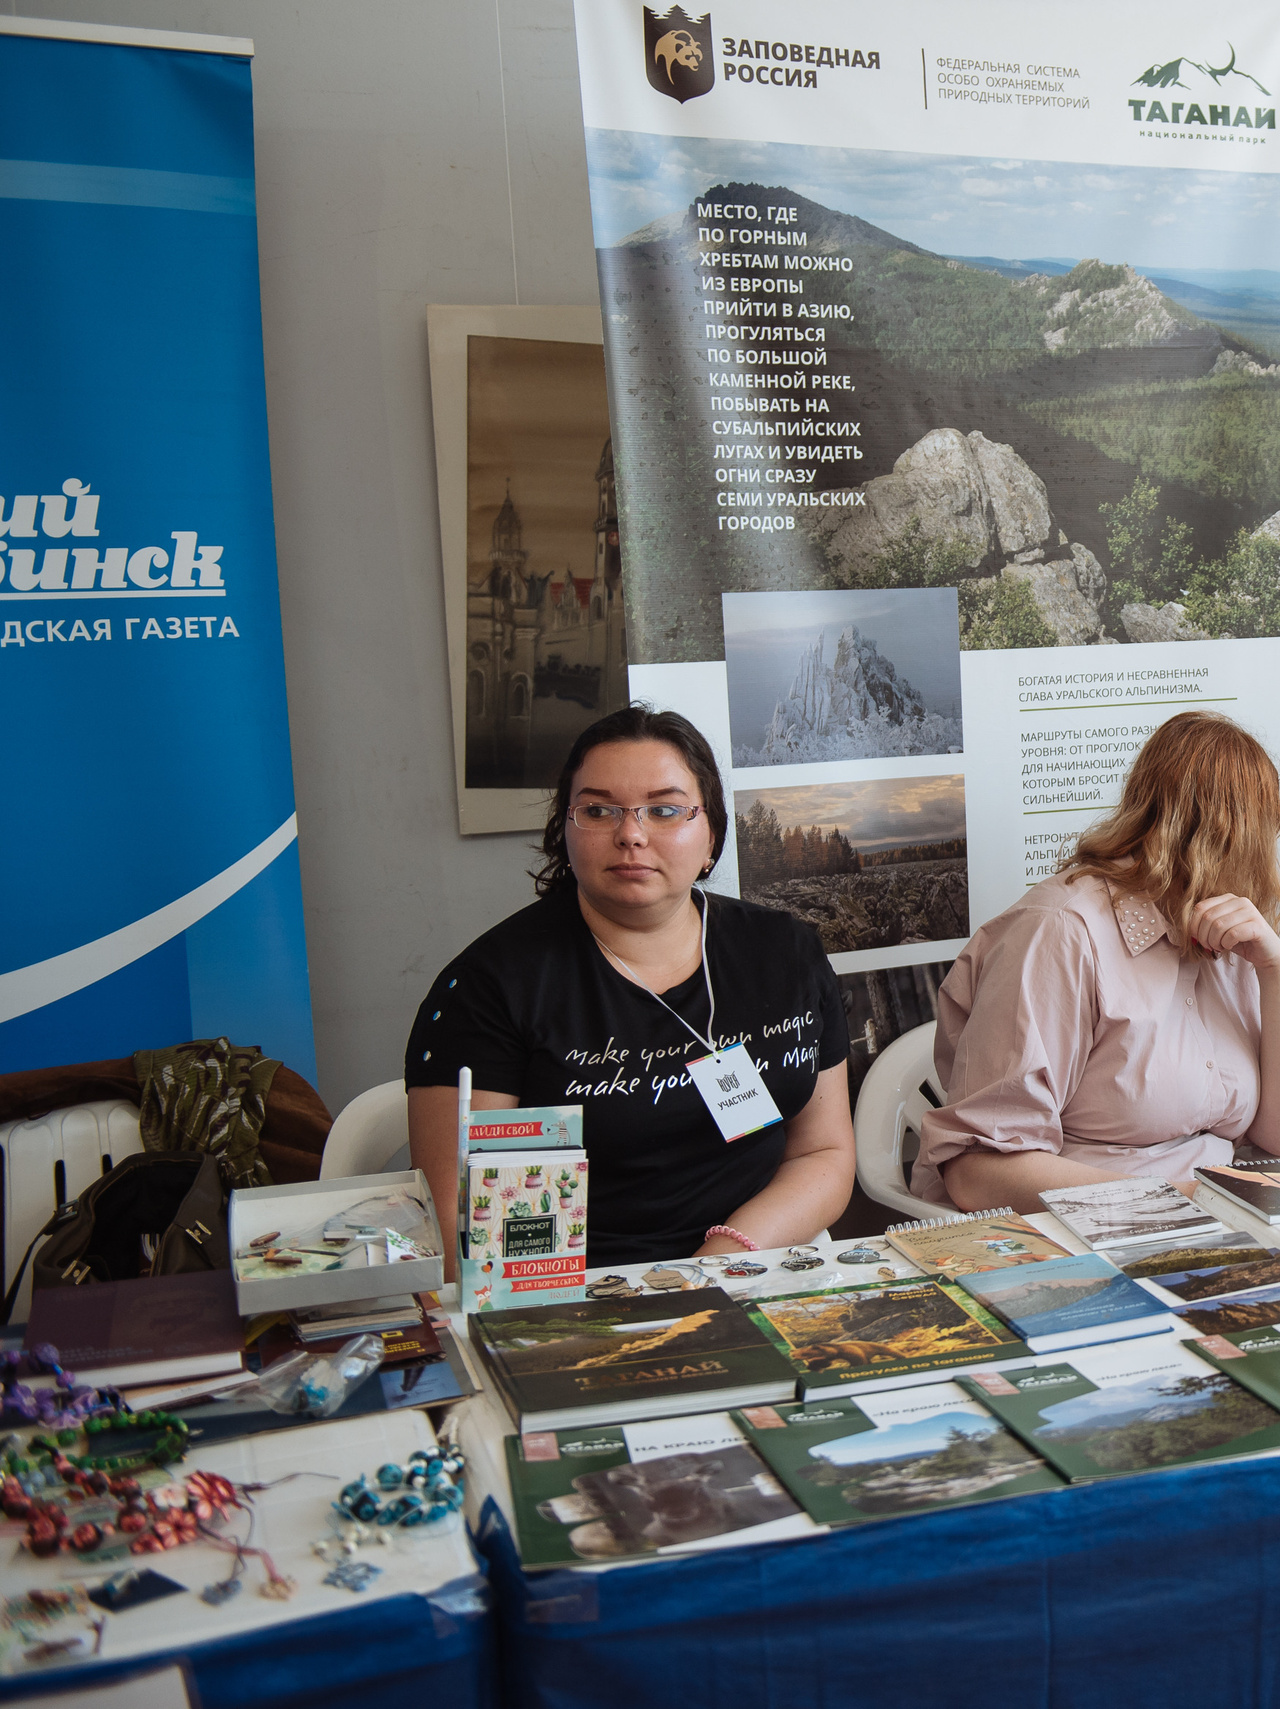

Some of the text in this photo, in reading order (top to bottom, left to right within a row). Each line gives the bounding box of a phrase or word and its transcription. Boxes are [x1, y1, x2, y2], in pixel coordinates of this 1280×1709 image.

[722, 37, 881, 70] ЗАПОВЕДНАЯ
[723, 62, 818, 89] РОССИЯ
[936, 57, 1081, 79] ФЕДЕРАЛЬНАЯ СИСТЕМА
[937, 72, 1065, 93] ОСОБО ОХРАНЯЕМЫХ
[938, 88, 1090, 109] ПРИРОДНЫХ ТЕРРИТОРИЙ
[1128, 99, 1276, 129] ТАГАНАЙ
[1139, 129, 1267, 145] национальный парк
[697, 203, 798, 225] МЕСТО, ГДЕ
[698, 227, 808, 246] ПО ГОРНЫМ
[699, 252, 853, 272] ХРЕБТАМ МОЖНО
[702, 276, 804, 294] ИЗ ЕВРОПЫ
[703, 298, 855, 321] ПРИЙТИ В АЗИЮ,
[705, 324, 826, 342] ПРОГУЛЯТЬСЯ
[707, 347, 827, 366] ПО БОЛЬШОЙ
[709, 371, 856, 392] КАМЕННОЙ РЕКЕ,
[711, 396, 830, 413] ПОБЫВАТЬ НА
[712, 418, 861, 436] СУБАЛЬПИЙСКИХ
[713, 444, 863, 463] ЛУГАХ И УВИДЕТЬ
[715, 468, 817, 483] ОГНИ СРАЗУ
[716, 492, 866, 507] СЕМИ УРАЛЬСКИХ
[718, 516, 795, 533] ГОРОДОВ
[0, 531, 225, 591] инск
[0, 616, 240, 648] ДСКАЯ ГАЗЕТА
[1018, 668, 1209, 687] БОГАТАЯ ИСТОРИЯ И НЕСРАВНЕННАЯ
[1018, 684, 1203, 702] СЛАВА УРАЛЬСКОГО АЛЬПИНИЗМА.
[1020, 730, 1082, 742] МАРШРУТЫ
[1084, 726, 1129, 739] САМОГО
[1021, 741, 1141, 758] УРОВНЯ: ОТ ПРОГУЛОК
[1021, 758, 1126, 776] ДЛЯ НАЧИНАЮЩИХ
[1022, 773, 1120, 789] КОТОРЫМ БРОСИТ
[1022, 791, 1104, 805] СИЛЬНЕЙШИЙ.
[1024, 831, 1082, 845] НЕТРОНУТ
[1025, 867, 1034, 876] И
[565, 1037, 630, 1066] make
[640, 1040, 696, 1071] your
[763, 1010, 814, 1041] magic
[565, 1039, 820, 1105] make you Magi
[717, 1088, 759, 1111] УЧАСТНИК
[506, 1122, 535, 1136] СВОЙ
[509, 1221, 551, 1232] БЛОКНОТ
[508, 1237, 551, 1250] ДЛЯ САМОГО
[511, 1258, 580, 1276] БЛОКНОТЫ
[533, 1276, 580, 1289] ТВОРЧЕСКИХ
[574, 1360, 724, 1386] ТАГАНАЙ
[839, 1353, 995, 1380] Прогулки по Таганаю
[663, 1440, 715, 1449] КРАЮ
